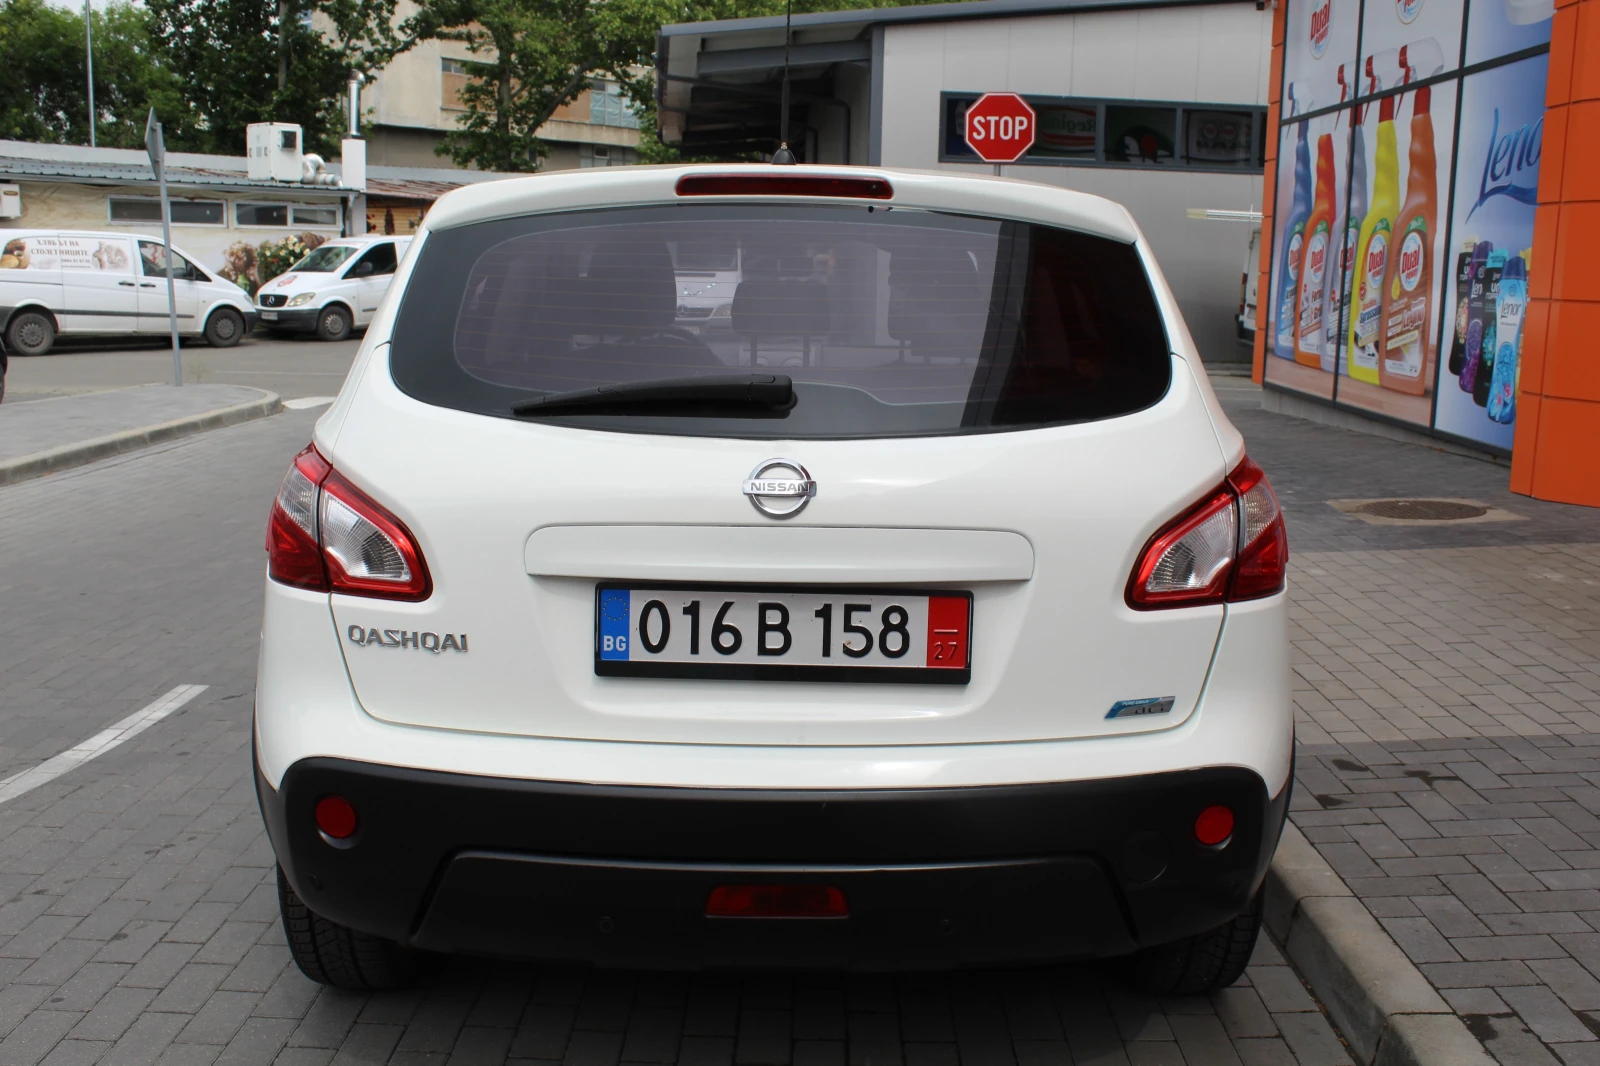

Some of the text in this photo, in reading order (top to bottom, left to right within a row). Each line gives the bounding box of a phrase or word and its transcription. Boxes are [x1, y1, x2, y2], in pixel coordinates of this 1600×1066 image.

[1311, 0, 1330, 40] Dual
[972, 115, 1028, 141] STOP
[1368, 244, 1386, 273] Dual
[1402, 244, 1421, 274] Dual
[1500, 298, 1522, 319] Lenor
[750, 481, 811, 493] NISSAN
[347, 624, 469, 653] QASHQAI
[603, 635, 627, 652] BG
[814, 602, 911, 659] 158
[933, 641, 957, 661] 27
